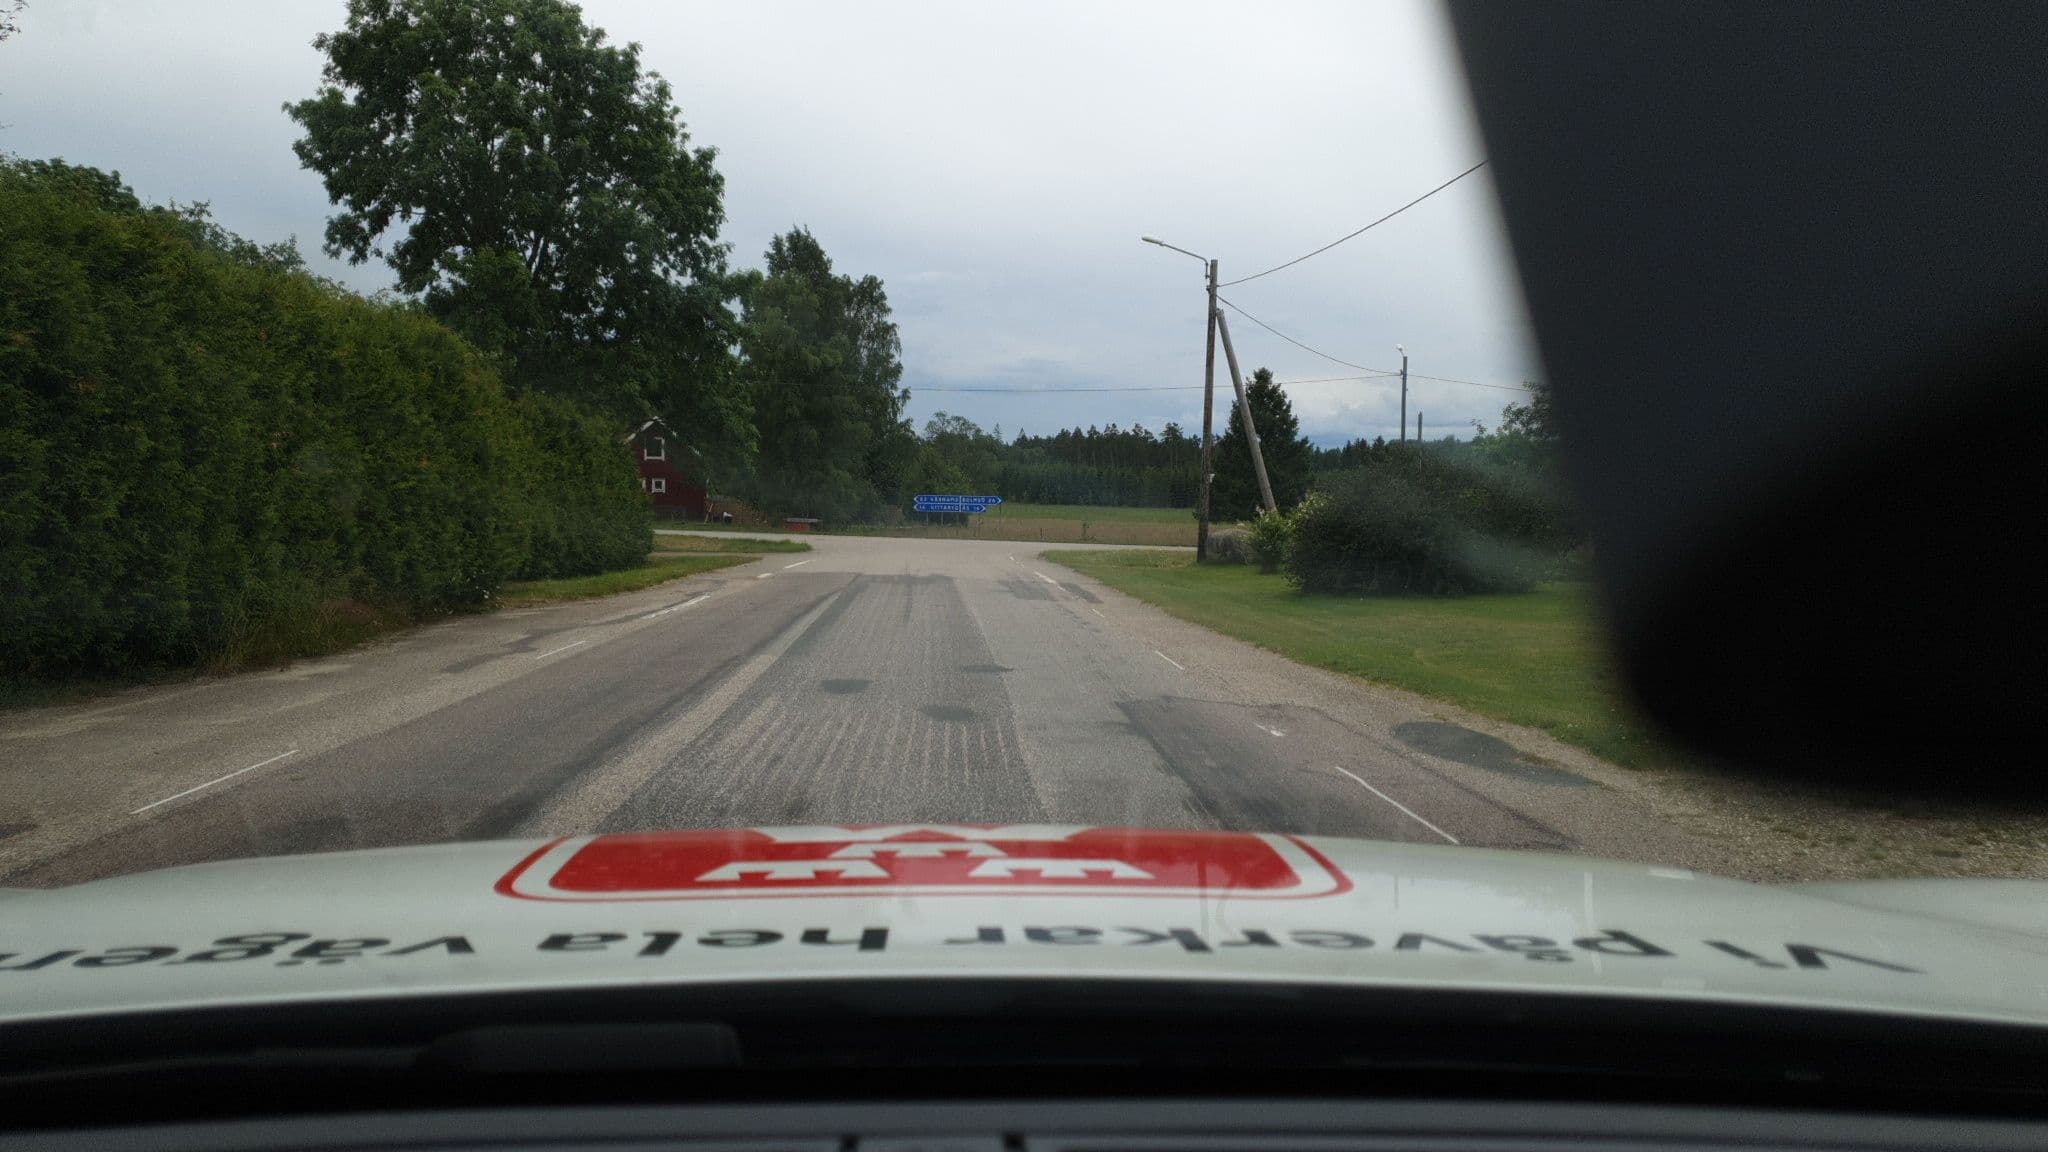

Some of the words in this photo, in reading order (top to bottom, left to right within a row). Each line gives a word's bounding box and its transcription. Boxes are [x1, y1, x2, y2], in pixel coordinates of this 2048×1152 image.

[0, 932, 474, 970] vägen
[537, 927, 889, 956] hela
[943, 926, 1676, 962] påverkar
[1703, 940, 1928, 973] Vi
